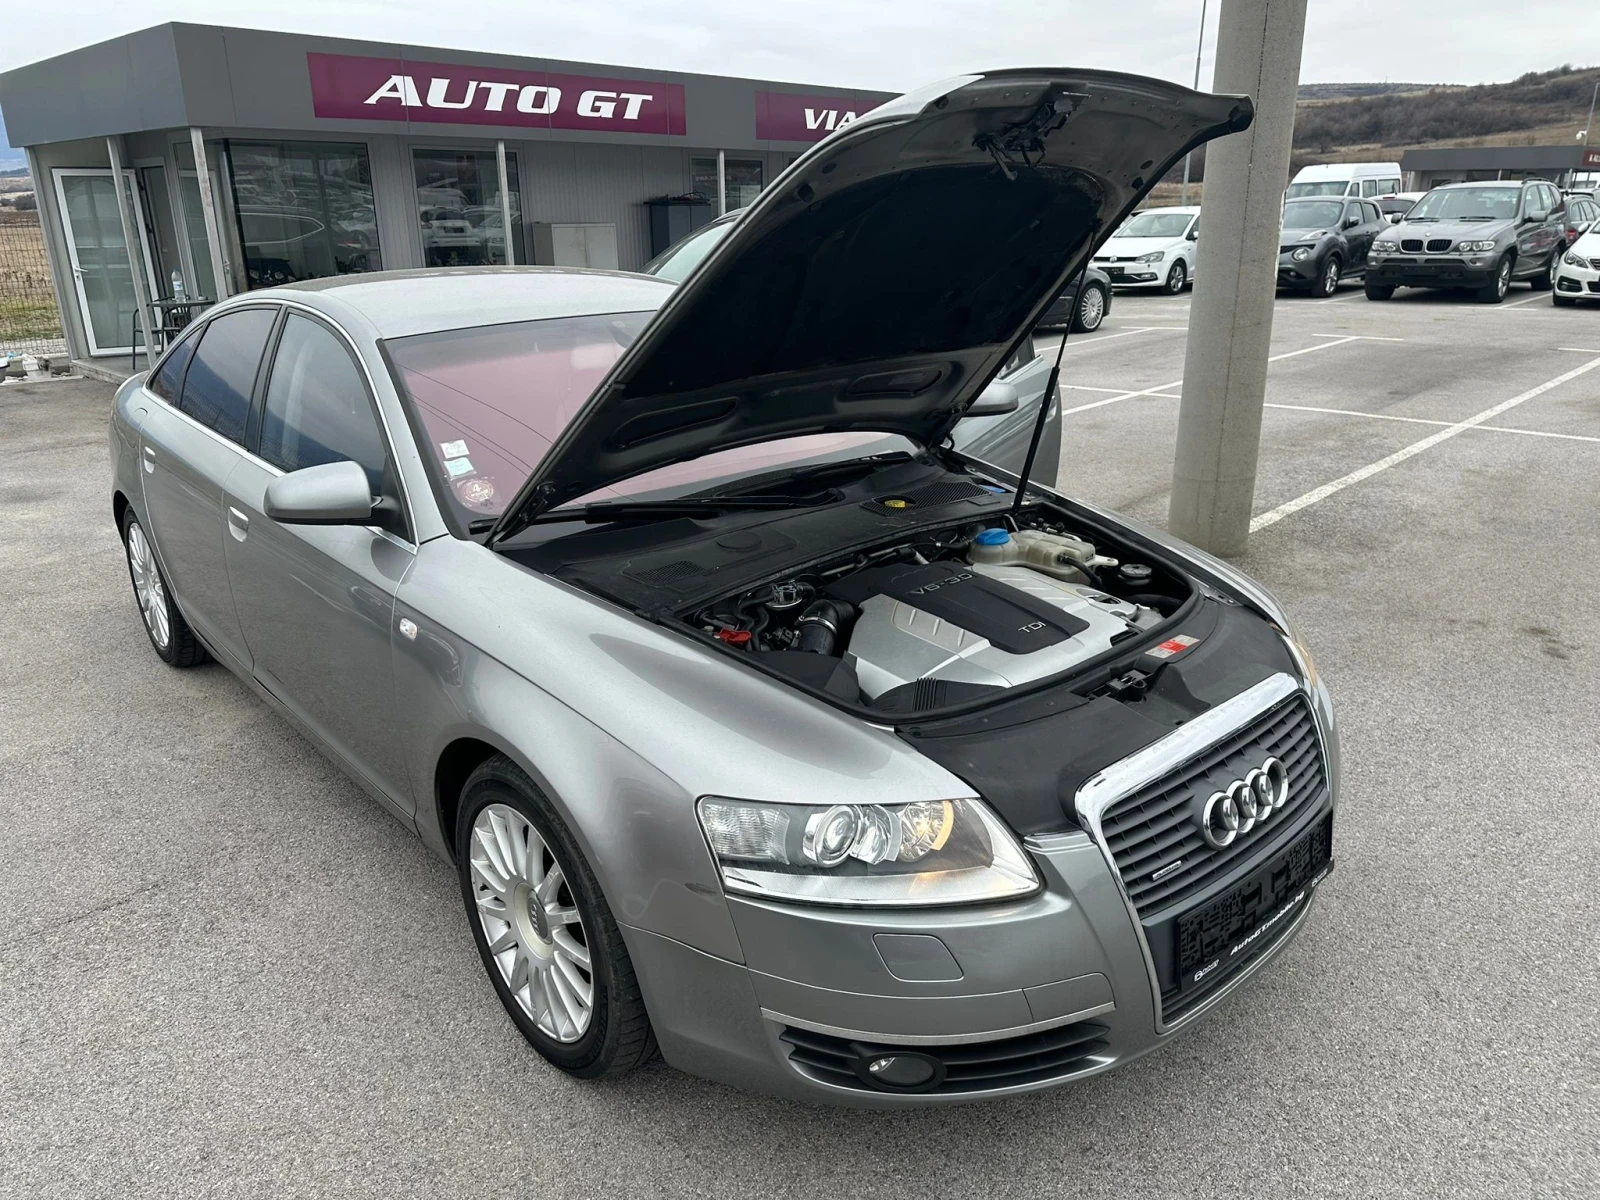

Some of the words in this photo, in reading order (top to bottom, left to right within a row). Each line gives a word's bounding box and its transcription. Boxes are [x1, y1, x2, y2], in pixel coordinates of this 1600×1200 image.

[363, 75, 562, 114] AUTO
[577, 90, 653, 120] GT
[1018, 621, 1046, 632] TDI
